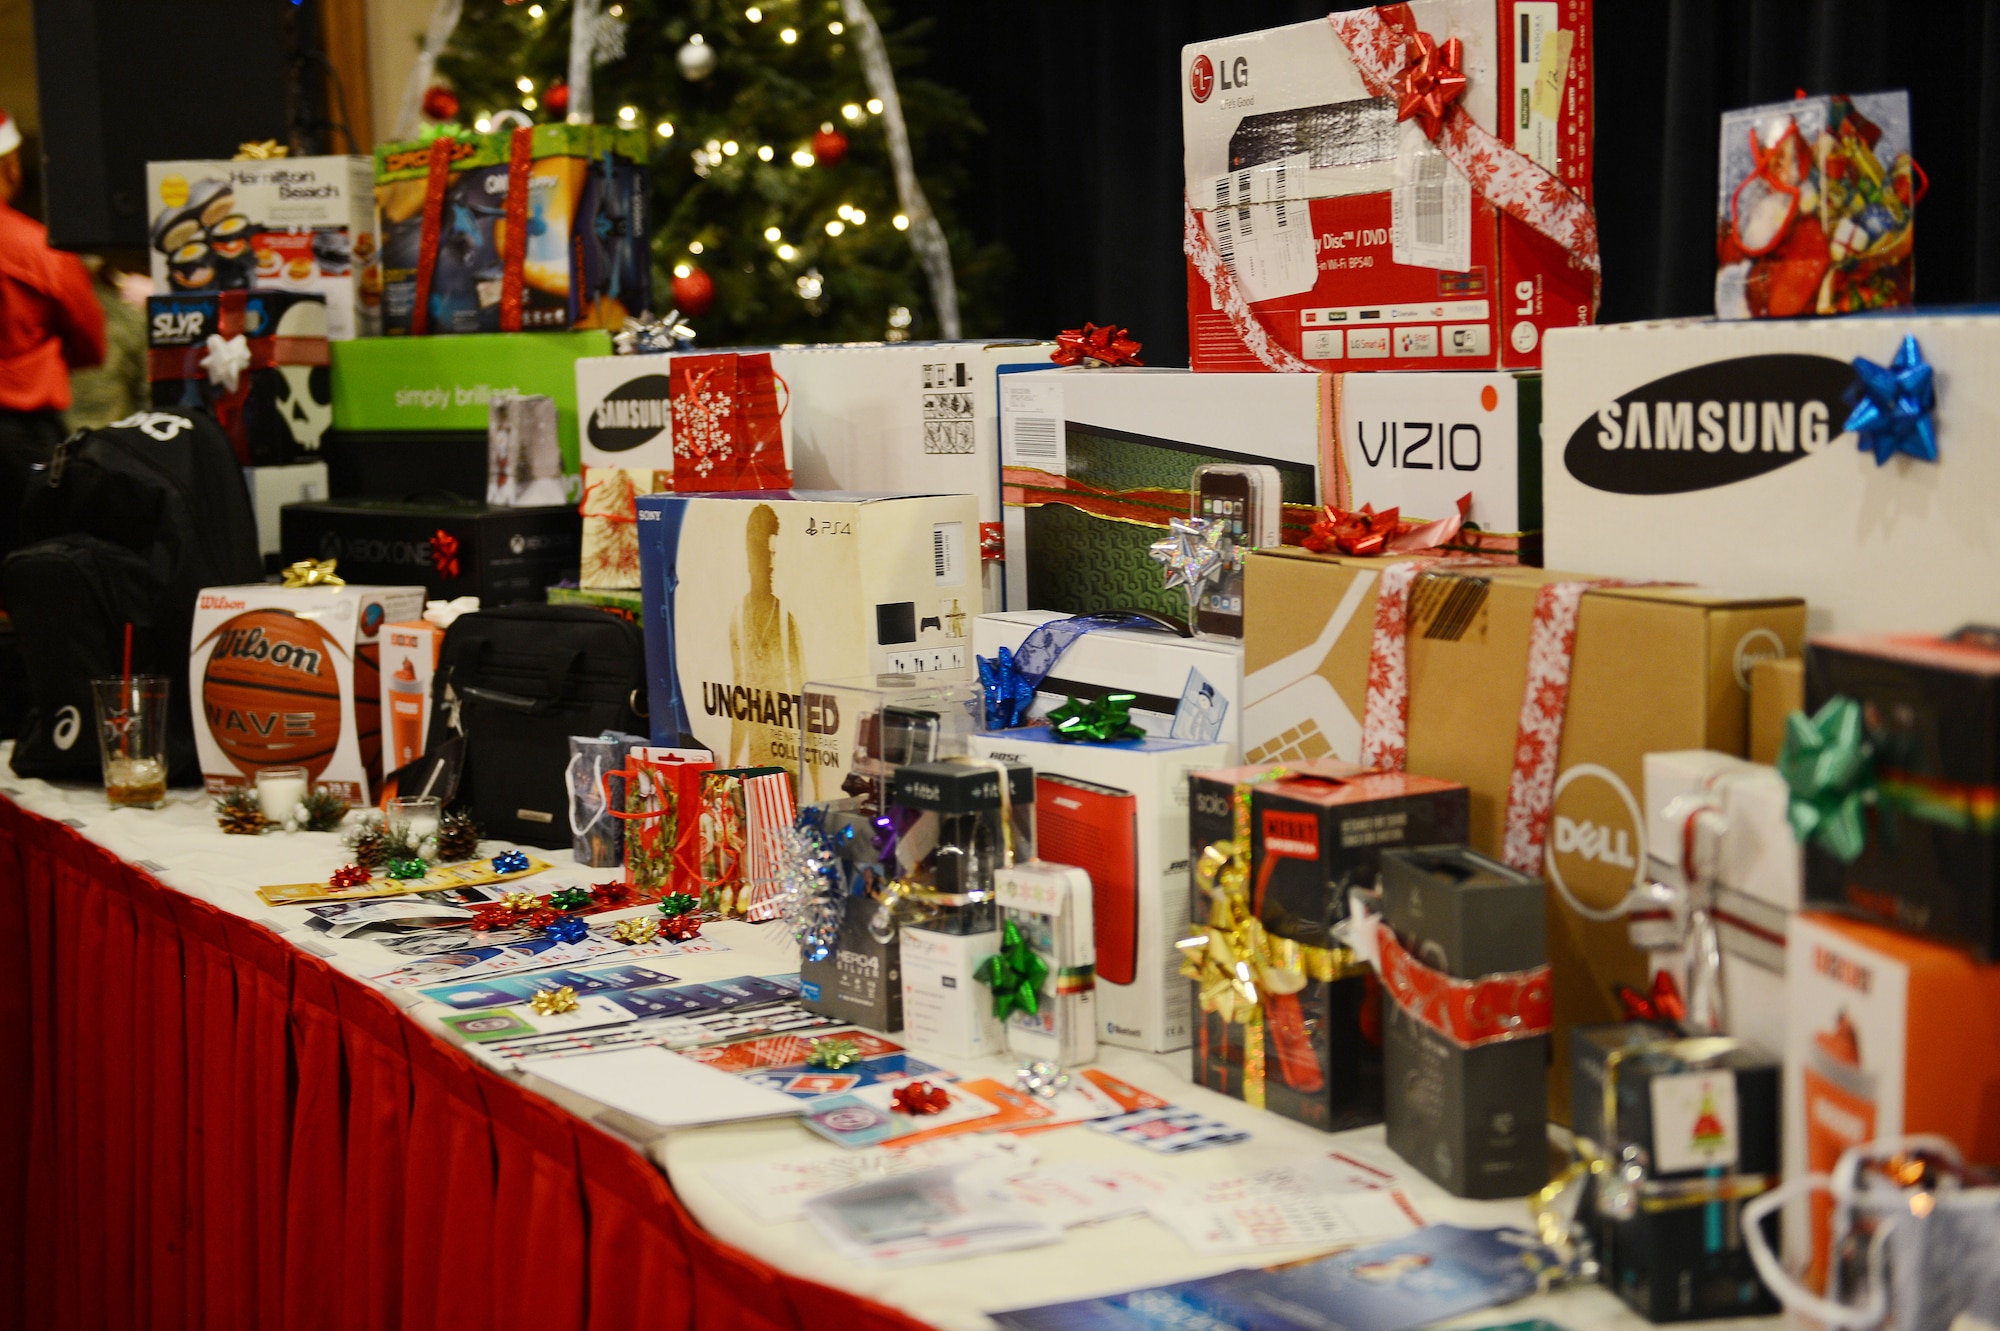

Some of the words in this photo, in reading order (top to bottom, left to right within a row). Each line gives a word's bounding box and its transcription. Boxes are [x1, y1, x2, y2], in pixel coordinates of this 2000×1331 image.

[1220, 56, 1248, 90] LG
[230, 169, 315, 184] Hamilton
[279, 183, 340, 199] Beach
[1362, 228, 1387, 247] DVD
[1515, 281, 1534, 316] LG
[152, 310, 204, 338] SLYR
[395, 386, 449, 410] simply
[597, 400, 670, 430] SAMSUNG
[1597, 400, 1830, 454] SAMSUNG
[1358, 421, 1482, 472] VIZIO
[639, 510, 662, 521] SONY
[821, 520, 852, 535] PS4
[200, 596, 246, 611] Wilson
[212, 626, 323, 676] Wilson
[702, 681, 840, 736] UNCHARTED
[1196, 793, 1229, 818] solo
[1554, 815, 1636, 870] DELL
[837, 949, 880, 970] HERO4
